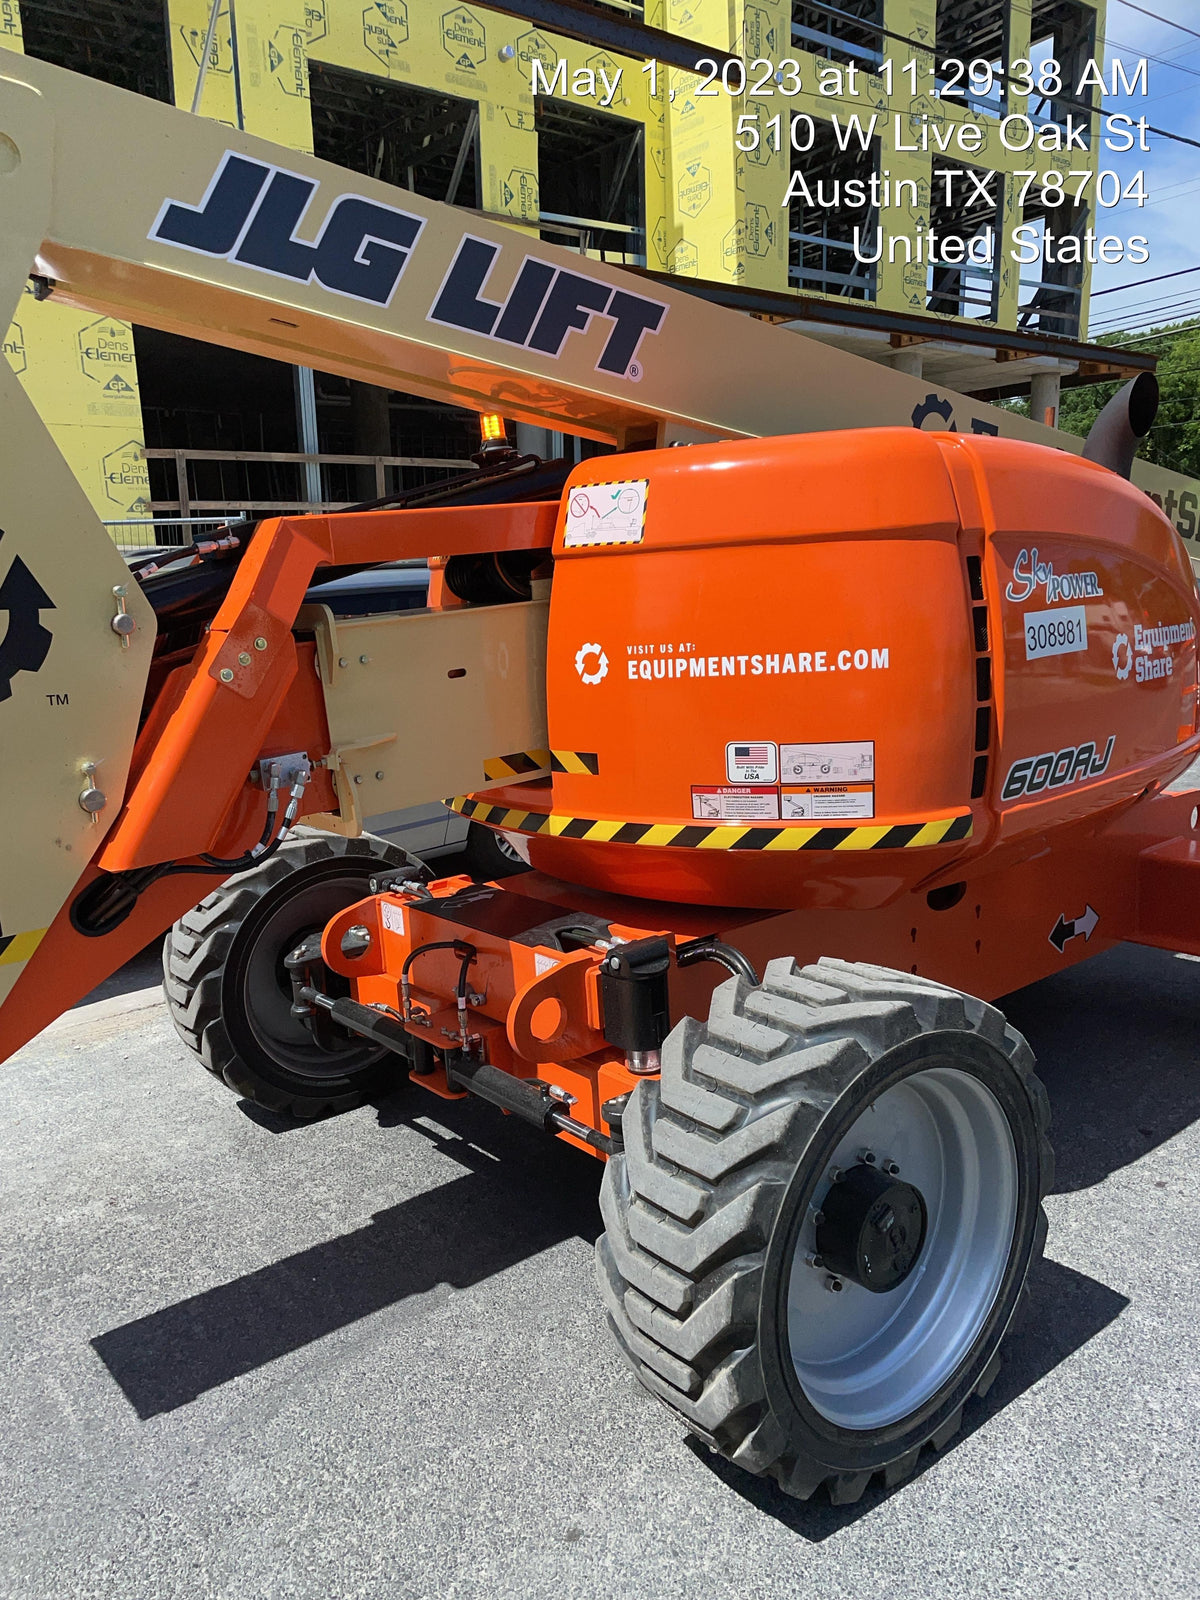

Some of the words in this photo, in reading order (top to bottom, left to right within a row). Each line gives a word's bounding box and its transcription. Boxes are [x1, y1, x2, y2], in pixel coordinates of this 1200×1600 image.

[443, 28, 486, 49] Element
[454, 22, 475, 37] Dens
[292, 28, 306, 97] Element
[459, 57, 472, 67] GP
[147, 149, 428, 308] JLG
[426, 232, 670, 379] LIFT
[98, 337, 128, 351] Dens
[109, 380, 126, 392] GP
[1006, 547, 1053, 604] Sky
[1027, 619, 1082, 651] 308981
[627, 644, 655, 655] VISIT
[660, 643, 674, 654] US
[679, 642, 696, 653] AT:
[627, 647, 889, 681] EQUIPMENTSHARE.COM
[1135, 655, 1173, 683] Share
[46, 693, 70, 706] TM
[1001, 735, 1116, 801] 600AJ
